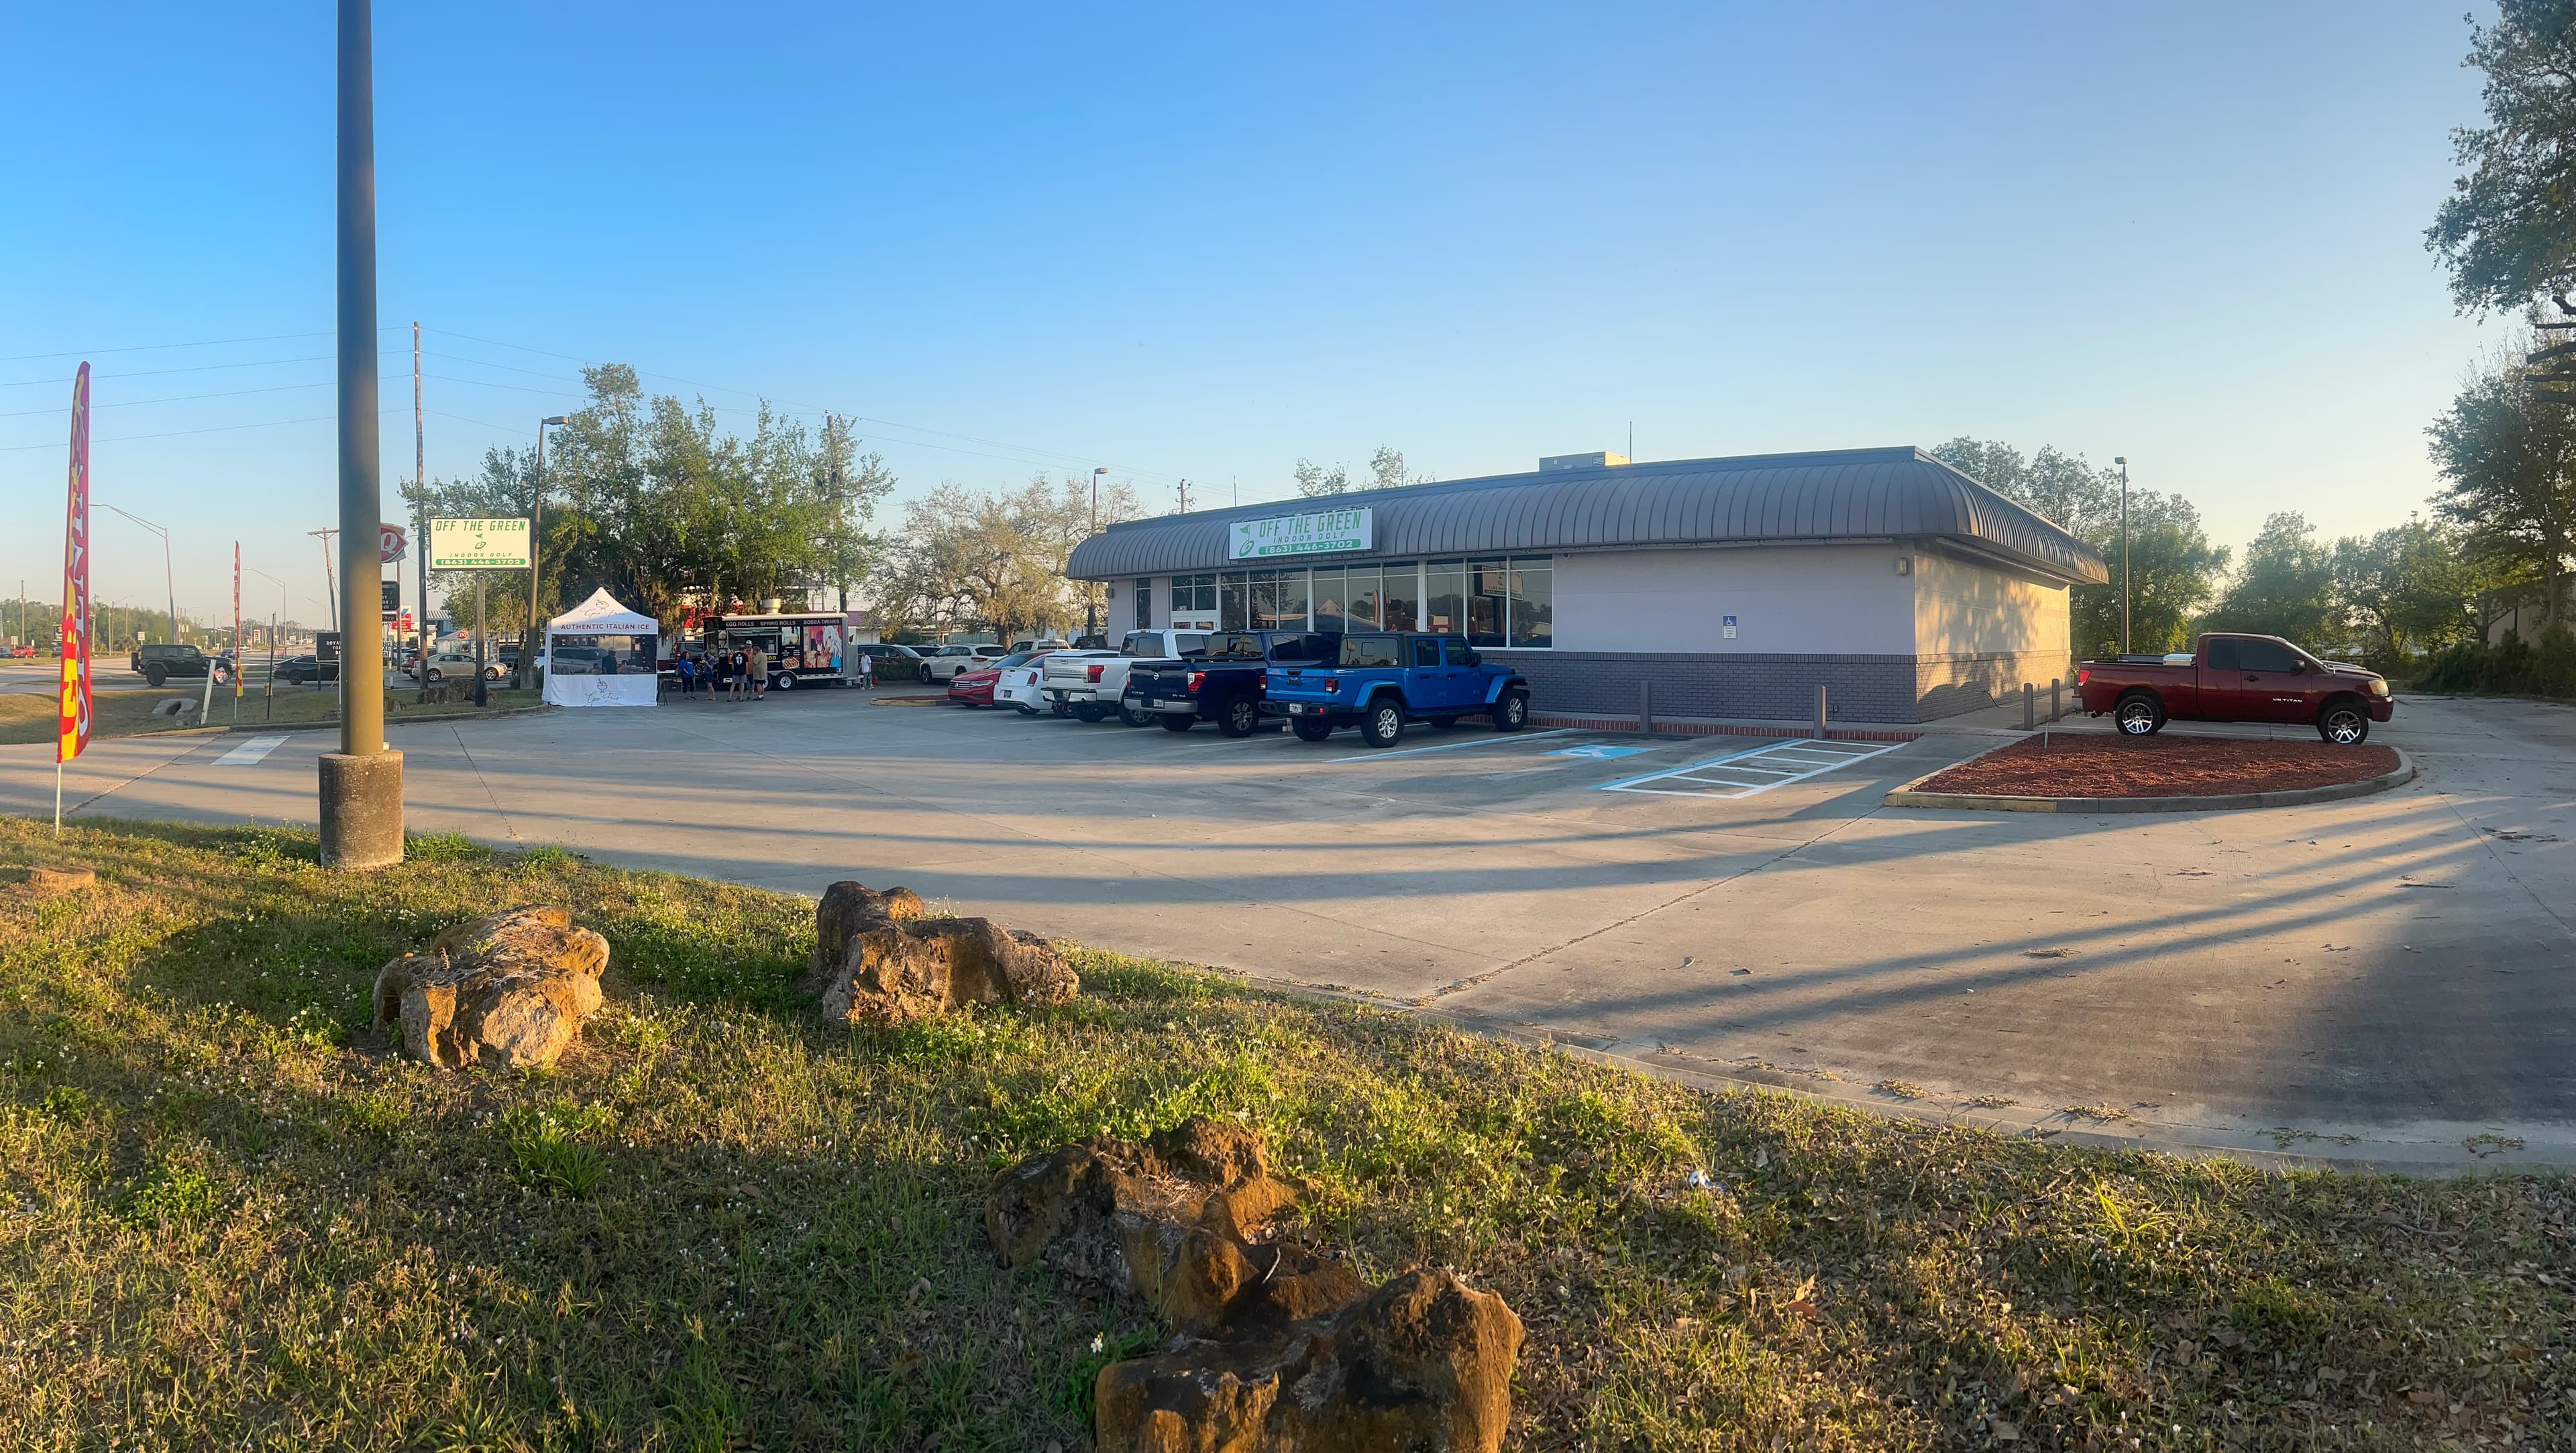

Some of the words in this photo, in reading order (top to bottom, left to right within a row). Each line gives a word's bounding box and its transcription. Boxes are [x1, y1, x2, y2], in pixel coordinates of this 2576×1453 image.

[435, 521, 457, 531] OFF
[464, 521, 484, 531] THE
[490, 521, 525, 531] GREEN
[1258, 520, 1281, 537] OFF
[1288, 517, 1311, 535] THE
[1318, 511, 1361, 532] GREEN
[381, 532, 397, 554] Q
[1273, 535, 1311, 544] INDOOR
[1318, 531, 1346, 539] GOLF
[1265, 545, 1292, 554] (863)
[1296, 541, 1353, 551] 446-3702
